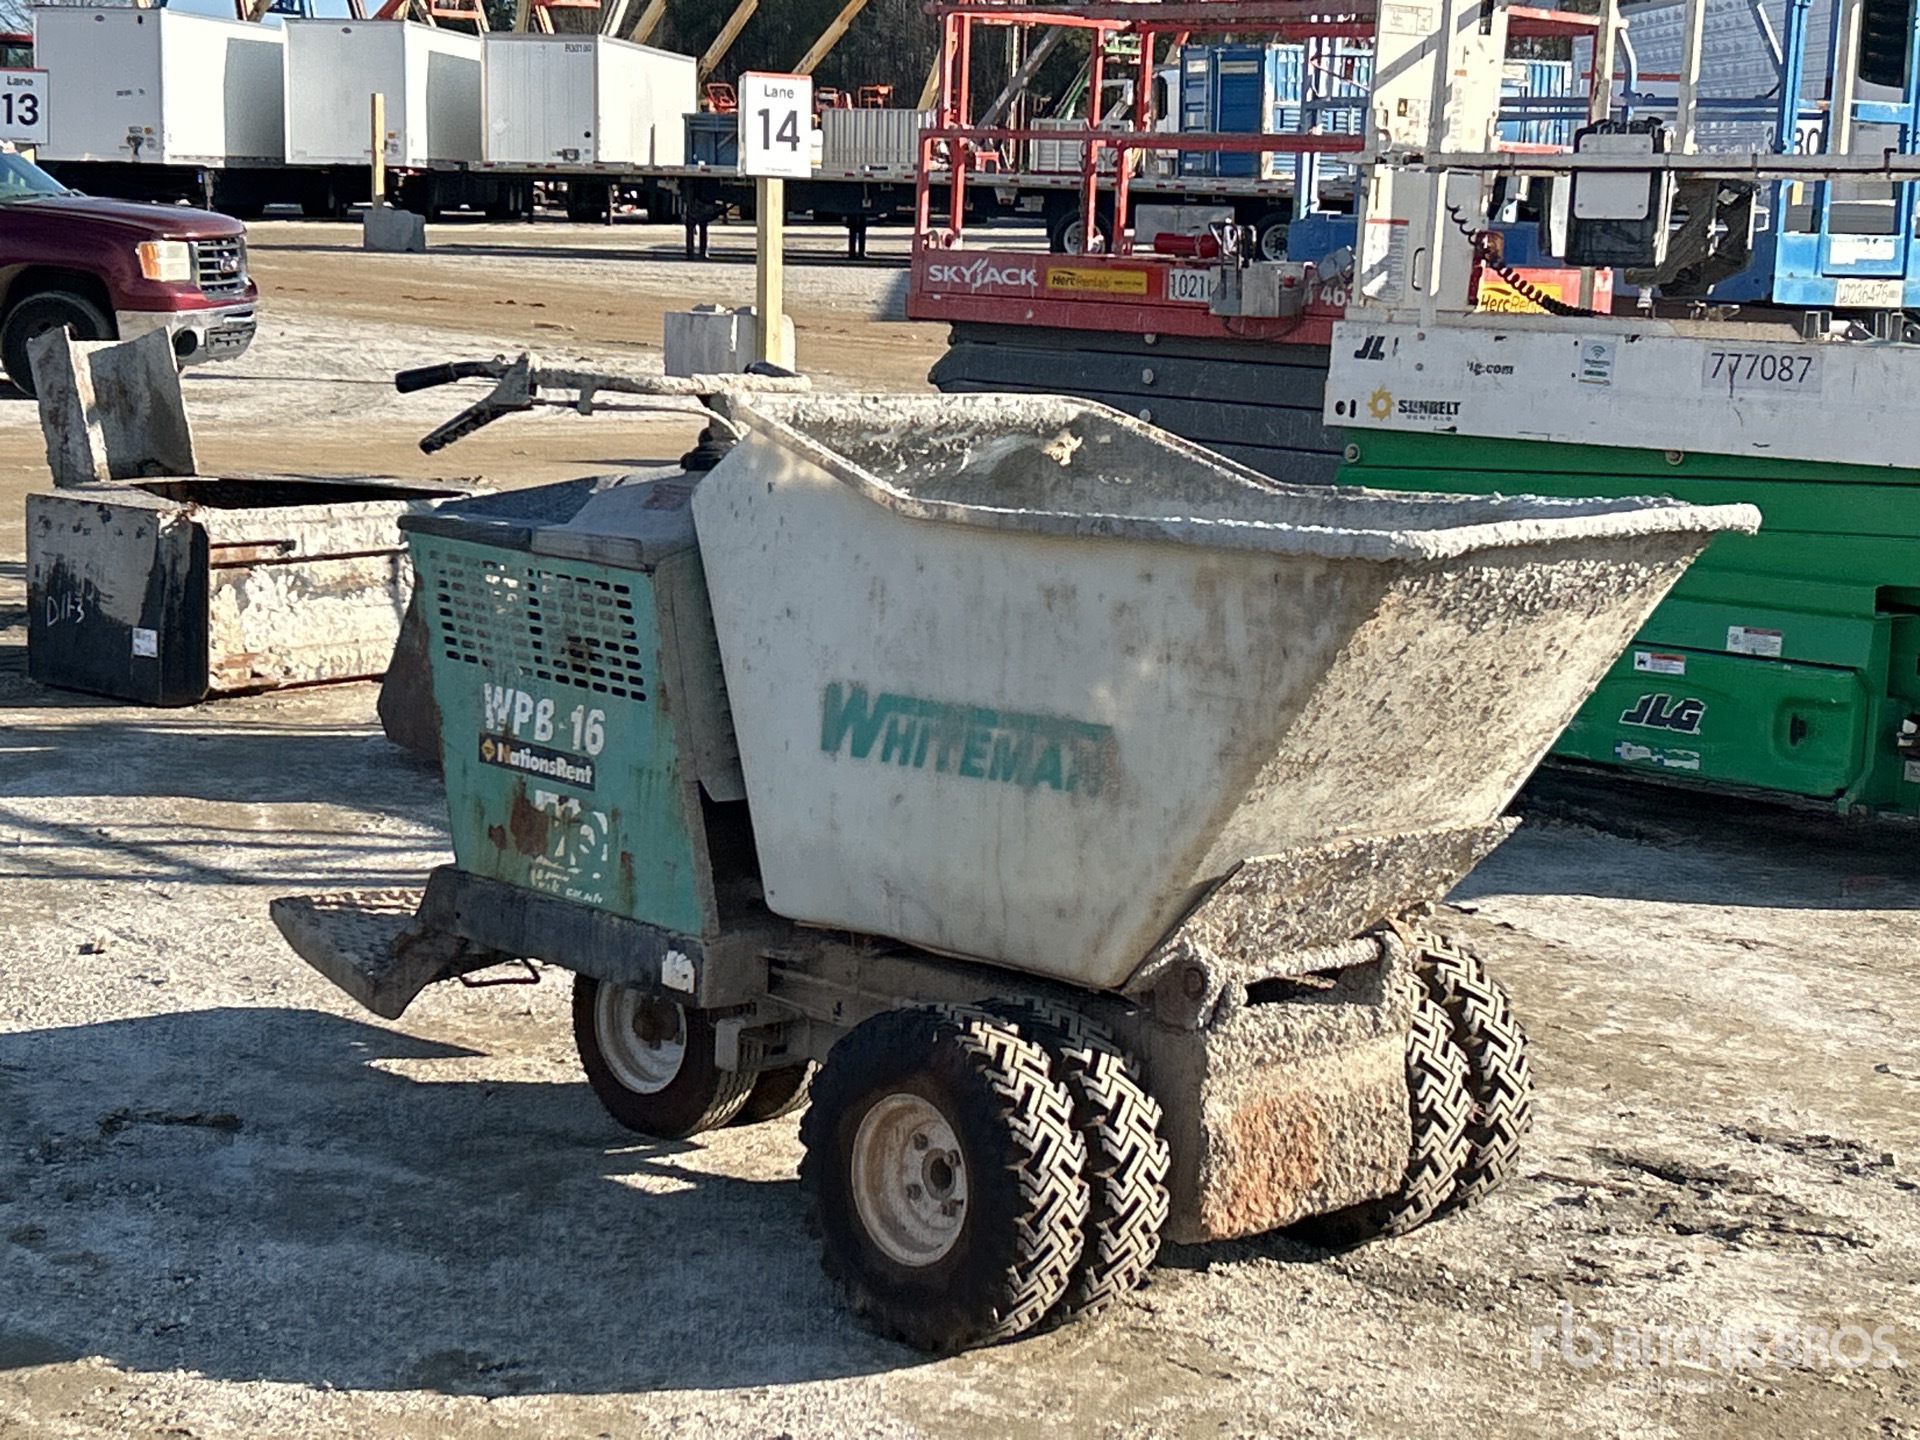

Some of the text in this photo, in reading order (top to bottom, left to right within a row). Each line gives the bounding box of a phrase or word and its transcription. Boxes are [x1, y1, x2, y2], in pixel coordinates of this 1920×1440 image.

[7, 75, 34, 87] Lane
[764, 84, 795, 99] Lane
[2, 92, 39, 126] 13
[757, 108, 800, 152] 14
[928, 257, 1039, 288] SKYJACK
[1711, 352, 1813, 384] 777087
[1398, 399, 1461, 416] SUNBELT
[1618, 693, 1708, 735] JLG
[497, 741, 593, 784] NationsRent
